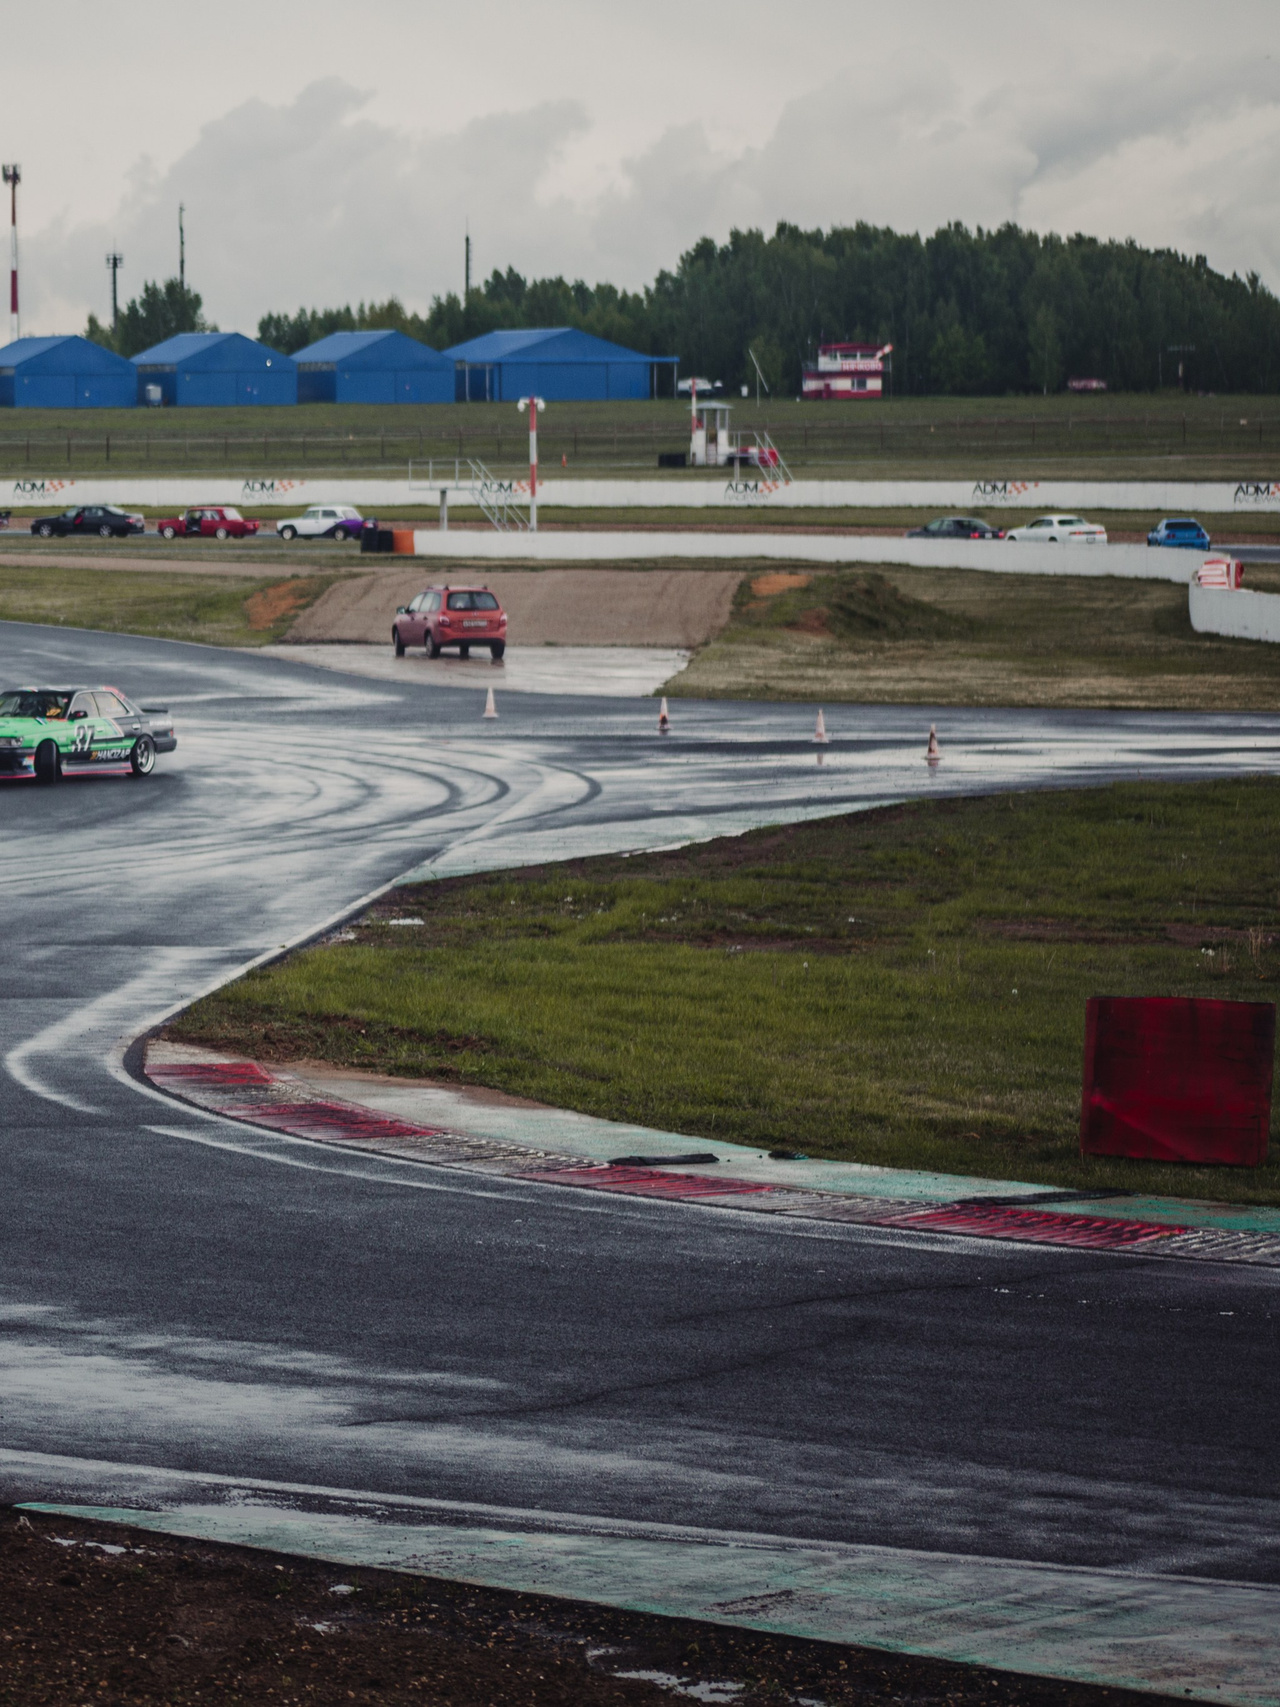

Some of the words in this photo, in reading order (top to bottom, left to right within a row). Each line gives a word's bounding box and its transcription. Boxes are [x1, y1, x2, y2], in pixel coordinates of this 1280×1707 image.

[14, 481, 45, 492] ADM
[243, 481, 274, 492] ADM
[725, 482, 758, 493] ADM
[972, 482, 1007, 494] ADM
[1235, 484, 1270, 496] ADM
[72, 724, 94, 752] 37
